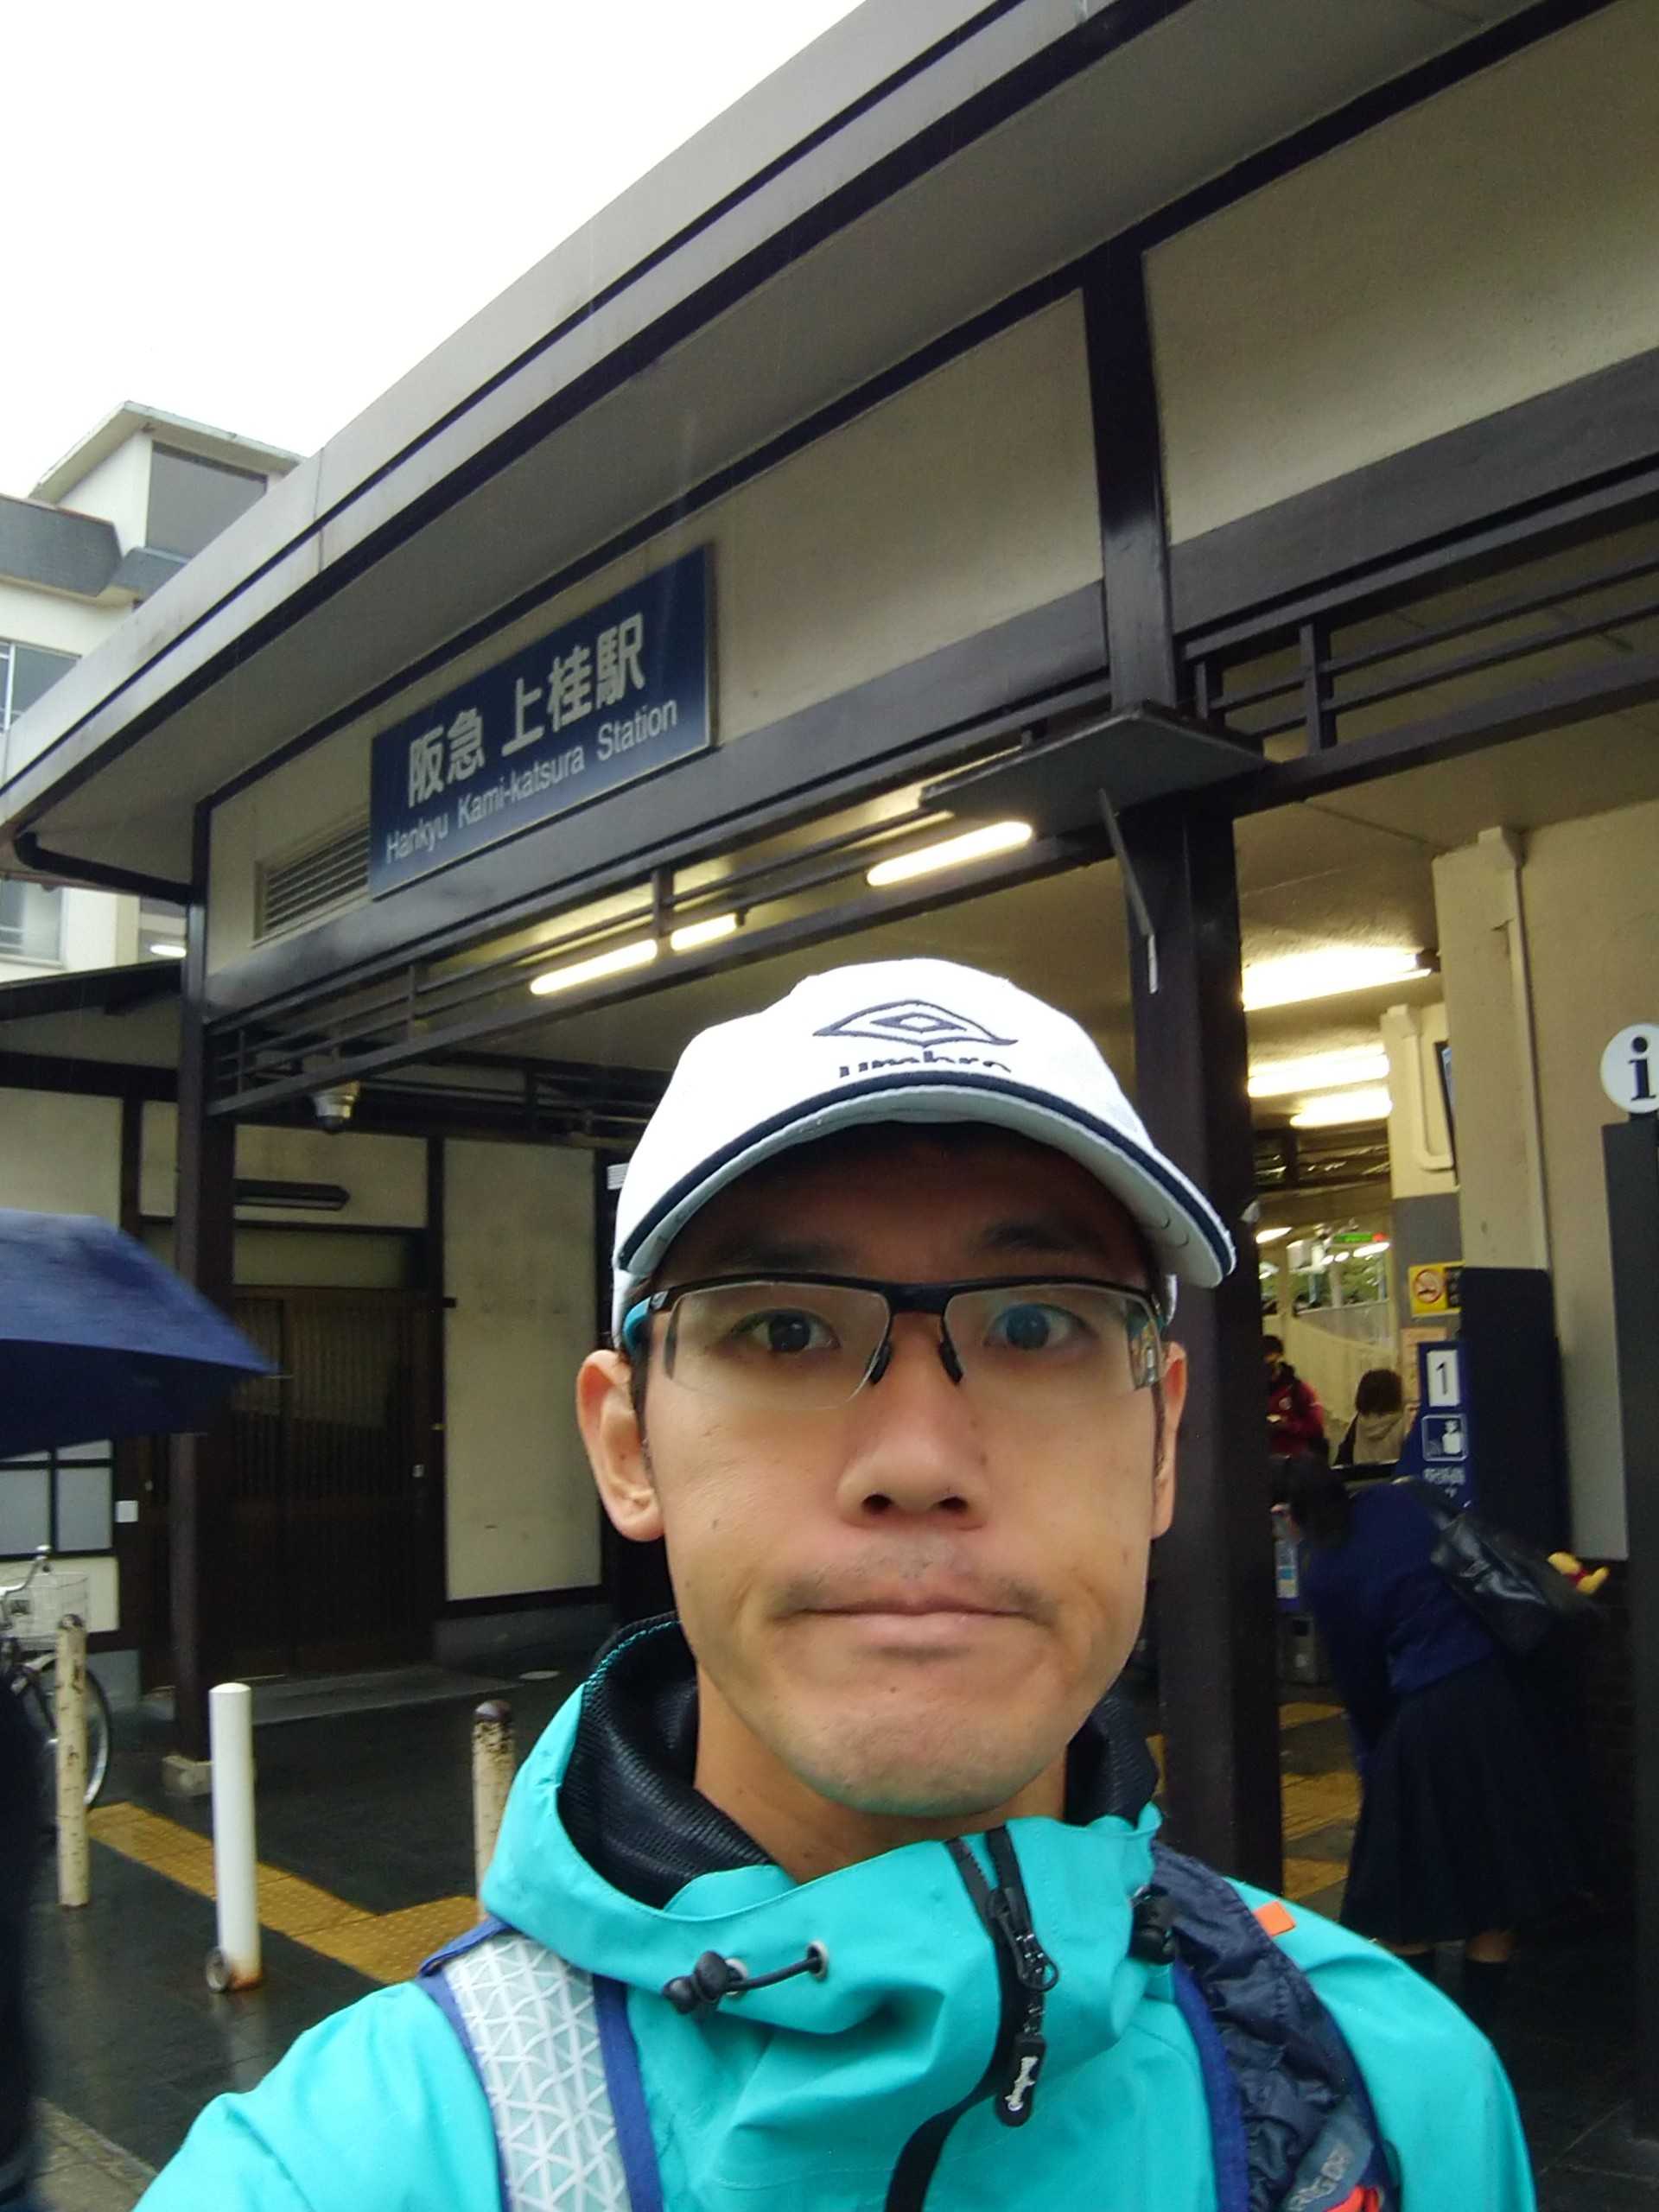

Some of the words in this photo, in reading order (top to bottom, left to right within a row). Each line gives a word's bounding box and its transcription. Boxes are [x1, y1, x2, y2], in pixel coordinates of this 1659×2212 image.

[386, 814, 449, 862] Hankyu
[458, 746, 586, 829] Kami-katsura
[598, 699, 677, 760] Station
[408, 706, 486, 808] 阪急
[501, 612, 646, 757] 上桂駅
[1435, 1362, 1447, 1395] 1
